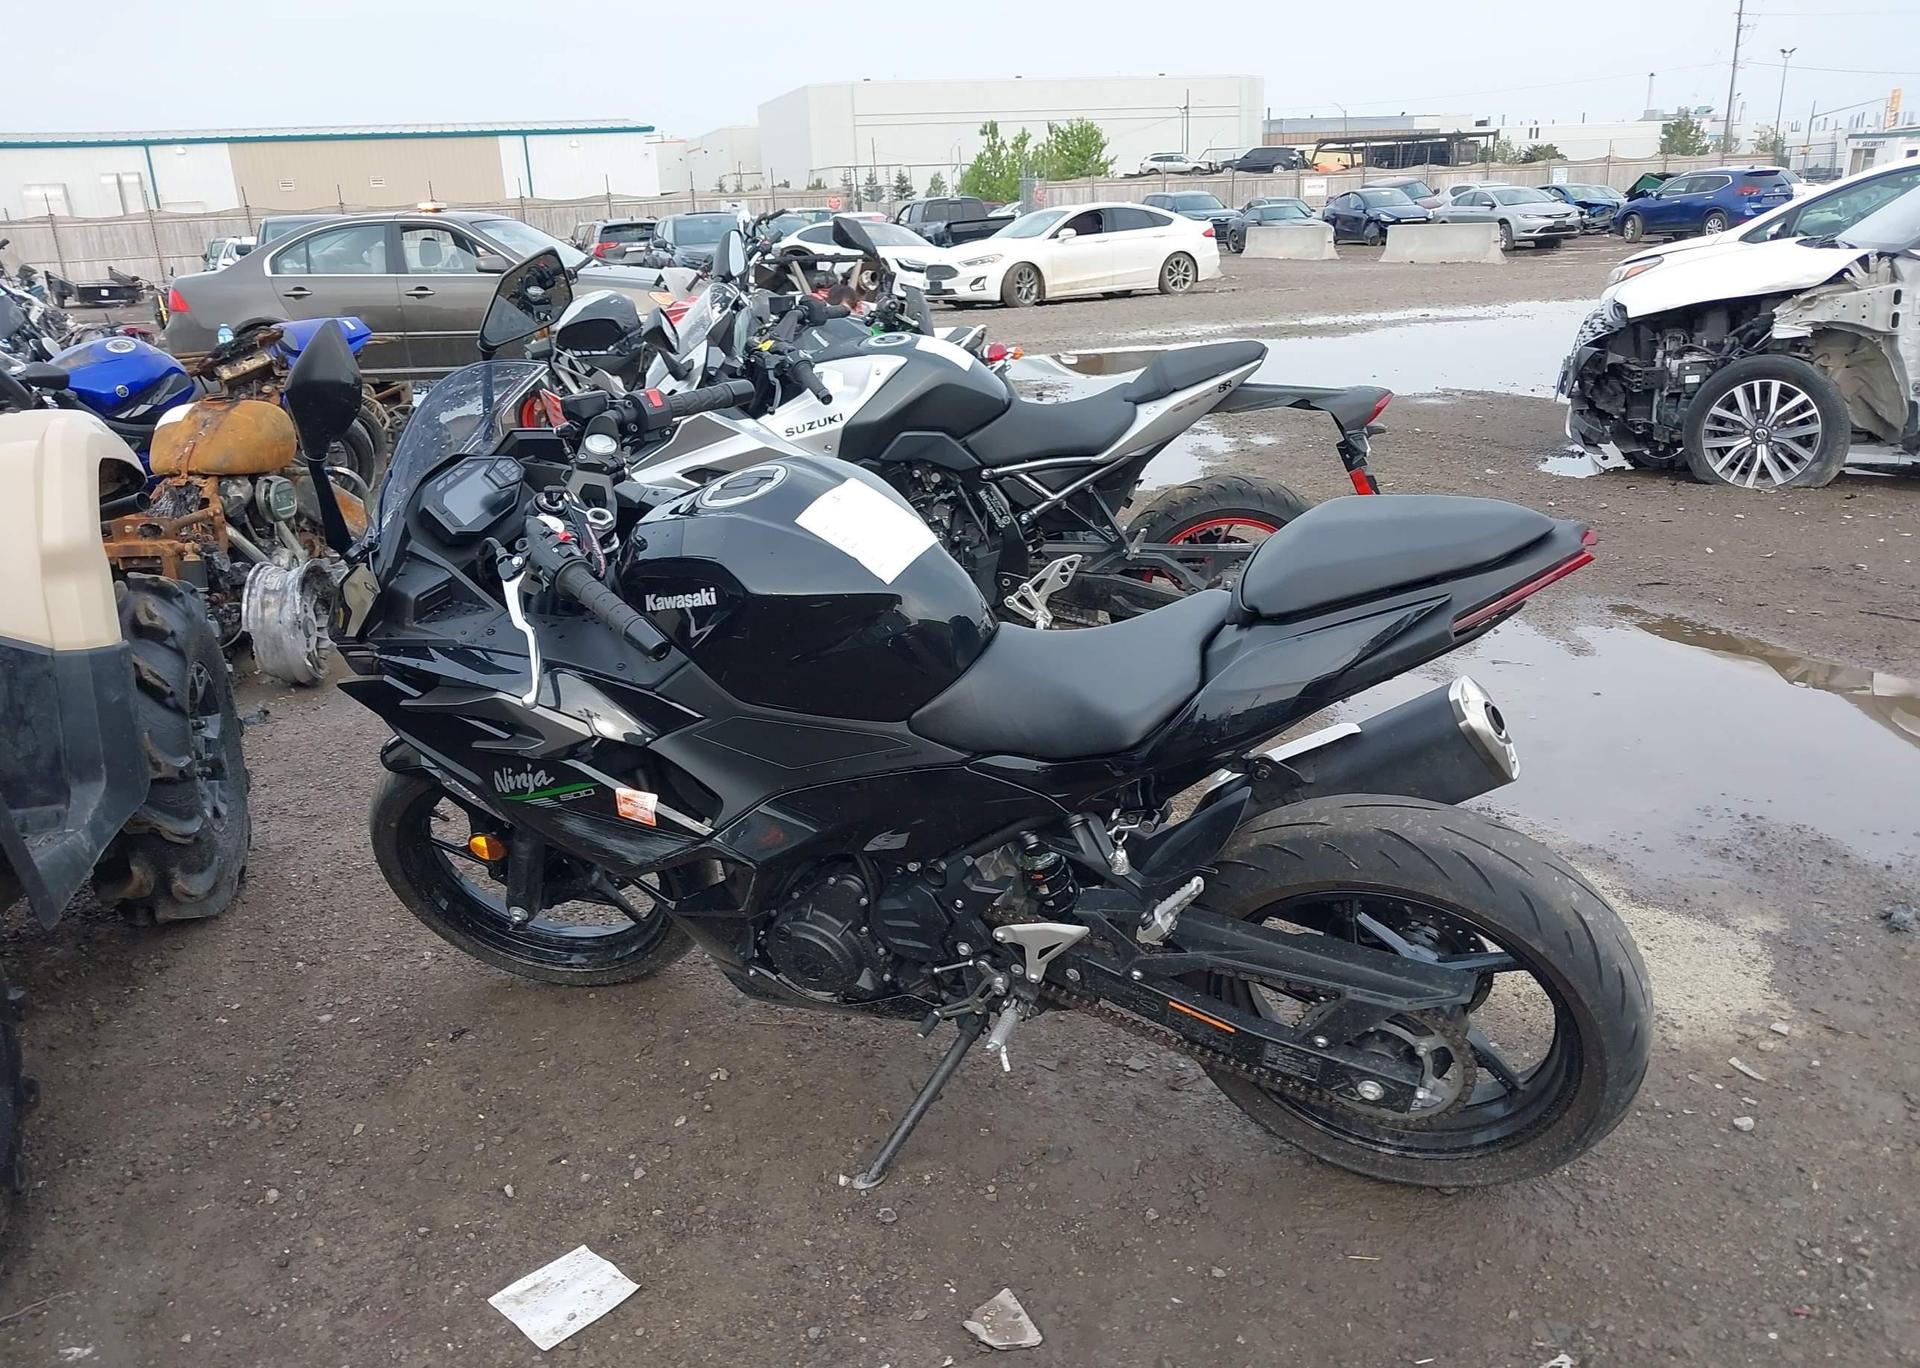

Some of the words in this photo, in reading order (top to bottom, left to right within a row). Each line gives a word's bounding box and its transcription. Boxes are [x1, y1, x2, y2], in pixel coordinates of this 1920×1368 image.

[785, 412, 844, 437] SUZUKI
[645, 587, 717, 612] Kawasaki
[493, 763, 556, 796] Ninja
[559, 788, 596, 802] 500
